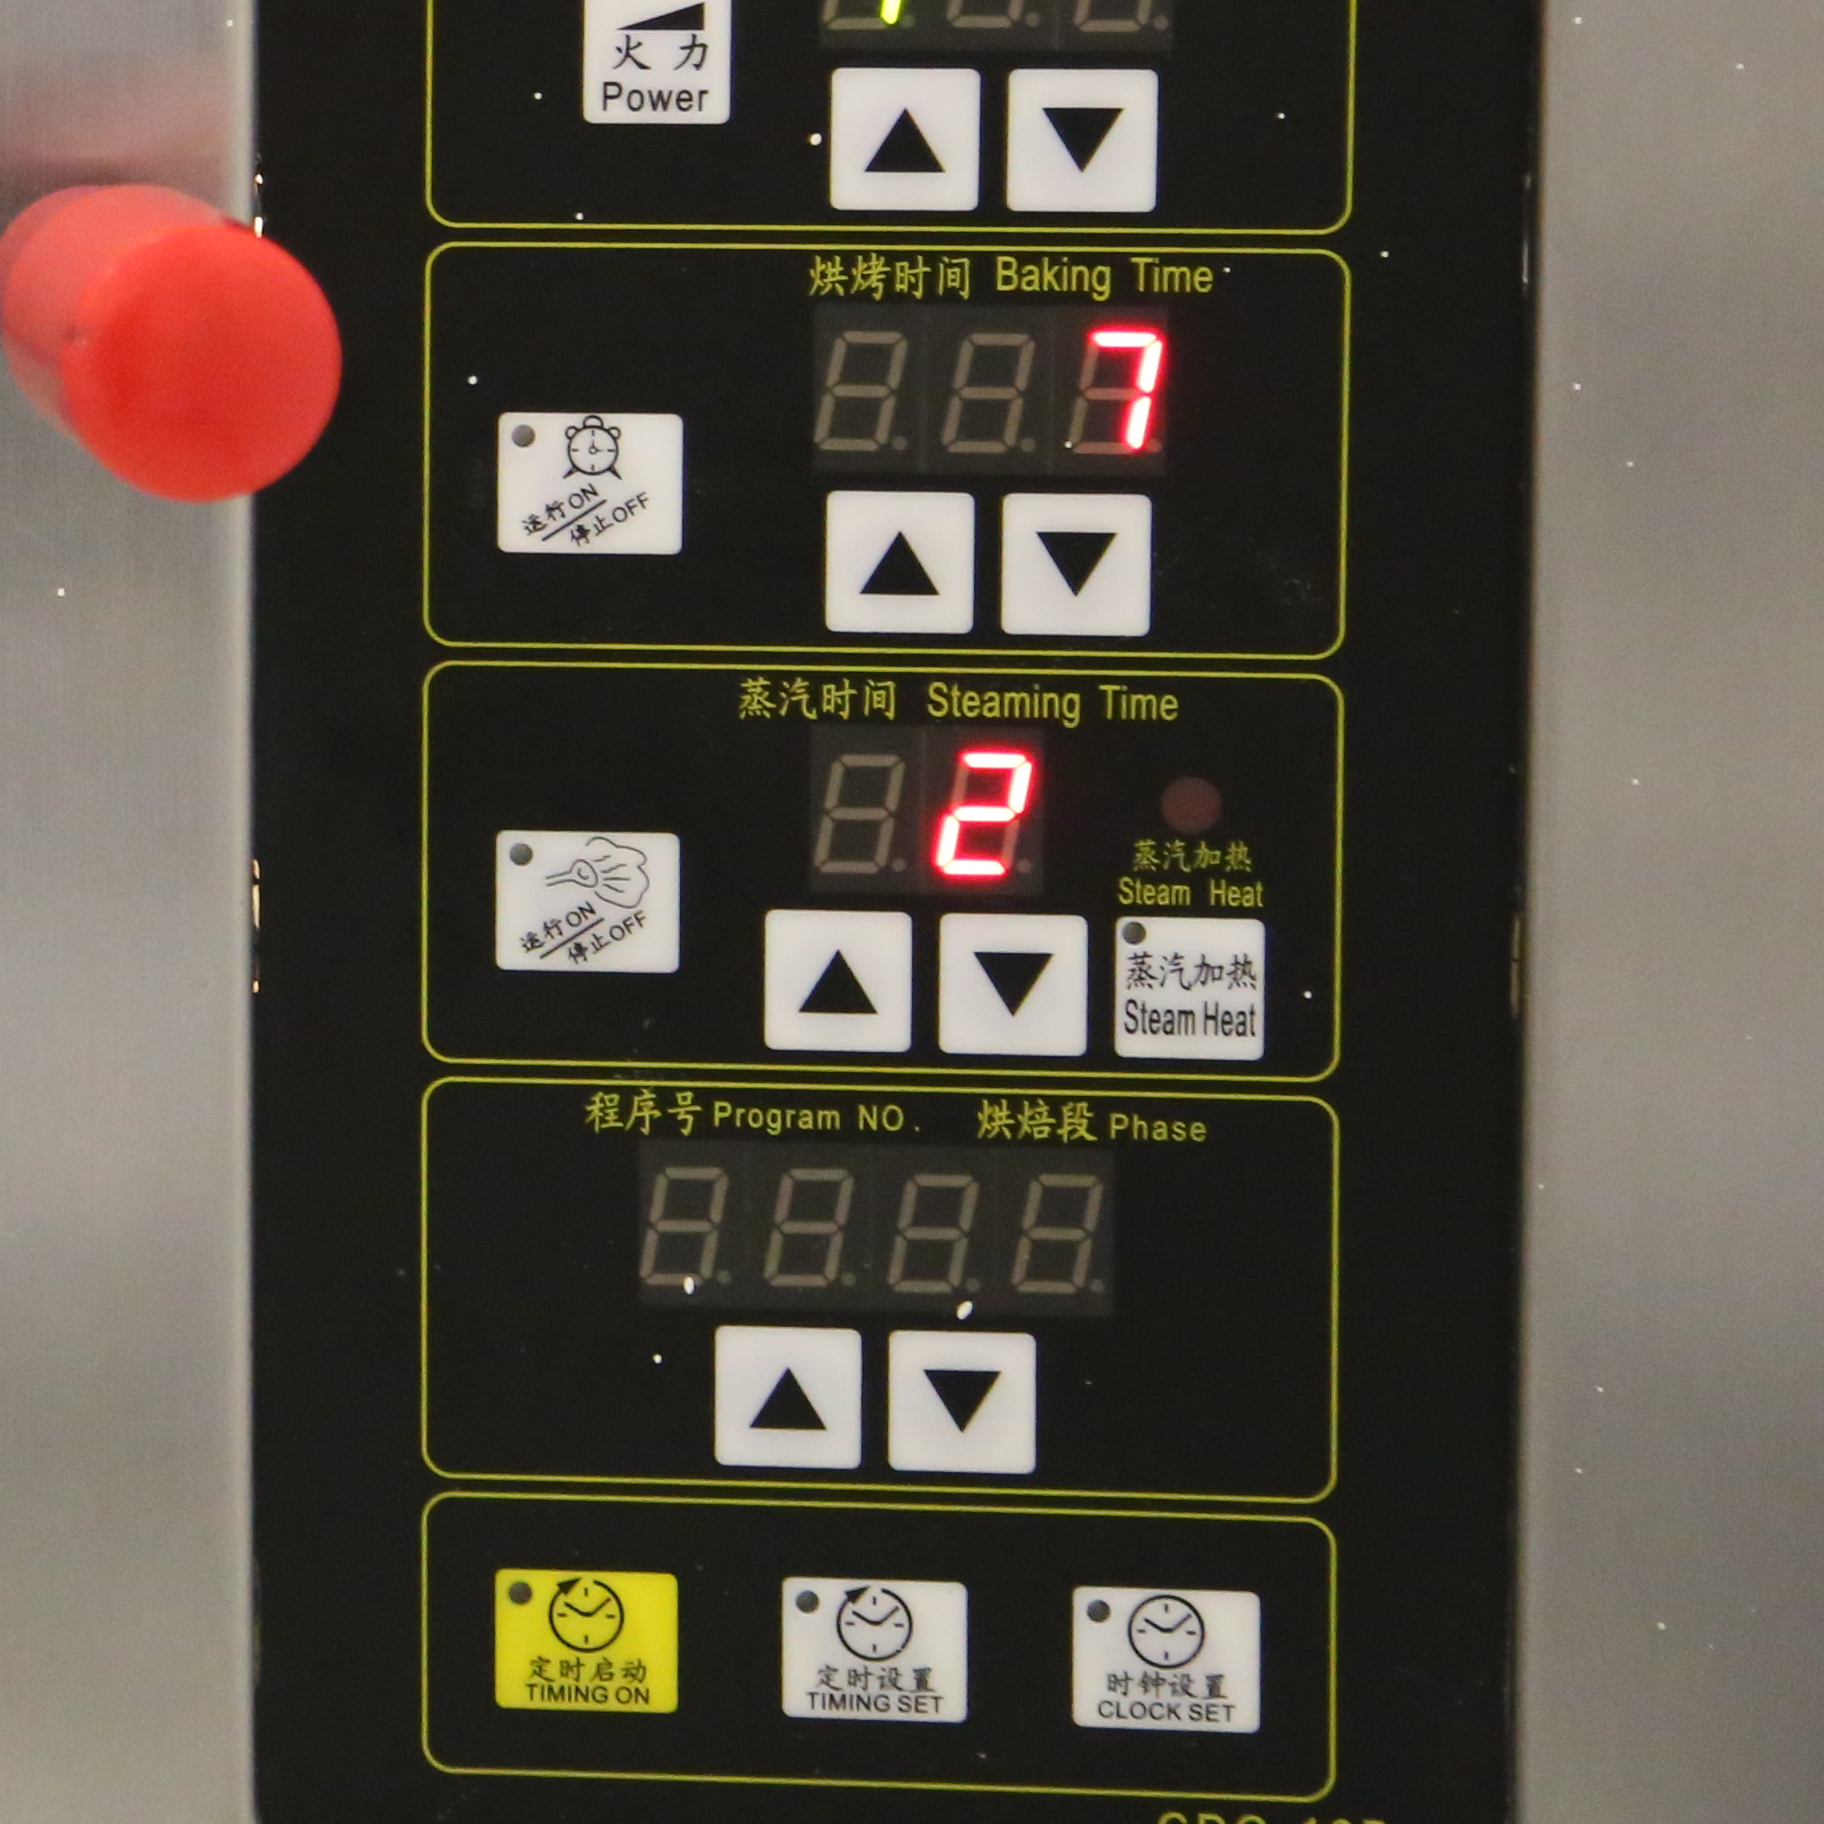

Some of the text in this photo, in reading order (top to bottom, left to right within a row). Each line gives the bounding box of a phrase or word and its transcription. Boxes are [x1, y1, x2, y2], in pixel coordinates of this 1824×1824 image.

[613, 33, 709, 71] 火力
[602, 81, 709, 112] Power
[809, 254, 971, 301] 烘烤时间
[996, 255, 1214, 302] Baking Time
[1088, 330, 1165, 452] 7
[739, 676, 896, 720] 蒸汽时间
[927, 681, 1179, 729] Steaming Time
[935, 751, 1034, 876] 2
[1133, 839, 1252, 873] 蒸汽加热
[1118, 877, 1264, 908] Steam Heat
[1126, 951, 1257, 991] 蒸汽加热
[1124, 999, 1256, 1038] Steam Heat
[585, 1090, 699, 1137] 程序号
[713, 1100, 841, 1136] Program
[977, 1099, 1098, 1144] 烘焙段
[1110, 1112, 1207, 1142] Phase
[525, 1655, 647, 1687] 定时启动
[811, 1660, 935, 1696] 定时设置
[1102, 1665, 1227, 1703] 时钟设置
[526, 1683, 650, 1705] TIMING ON
[807, 1688, 943, 1714] TIMING SET
[1097, 1699, 1235, 1723] CLOCK SET
